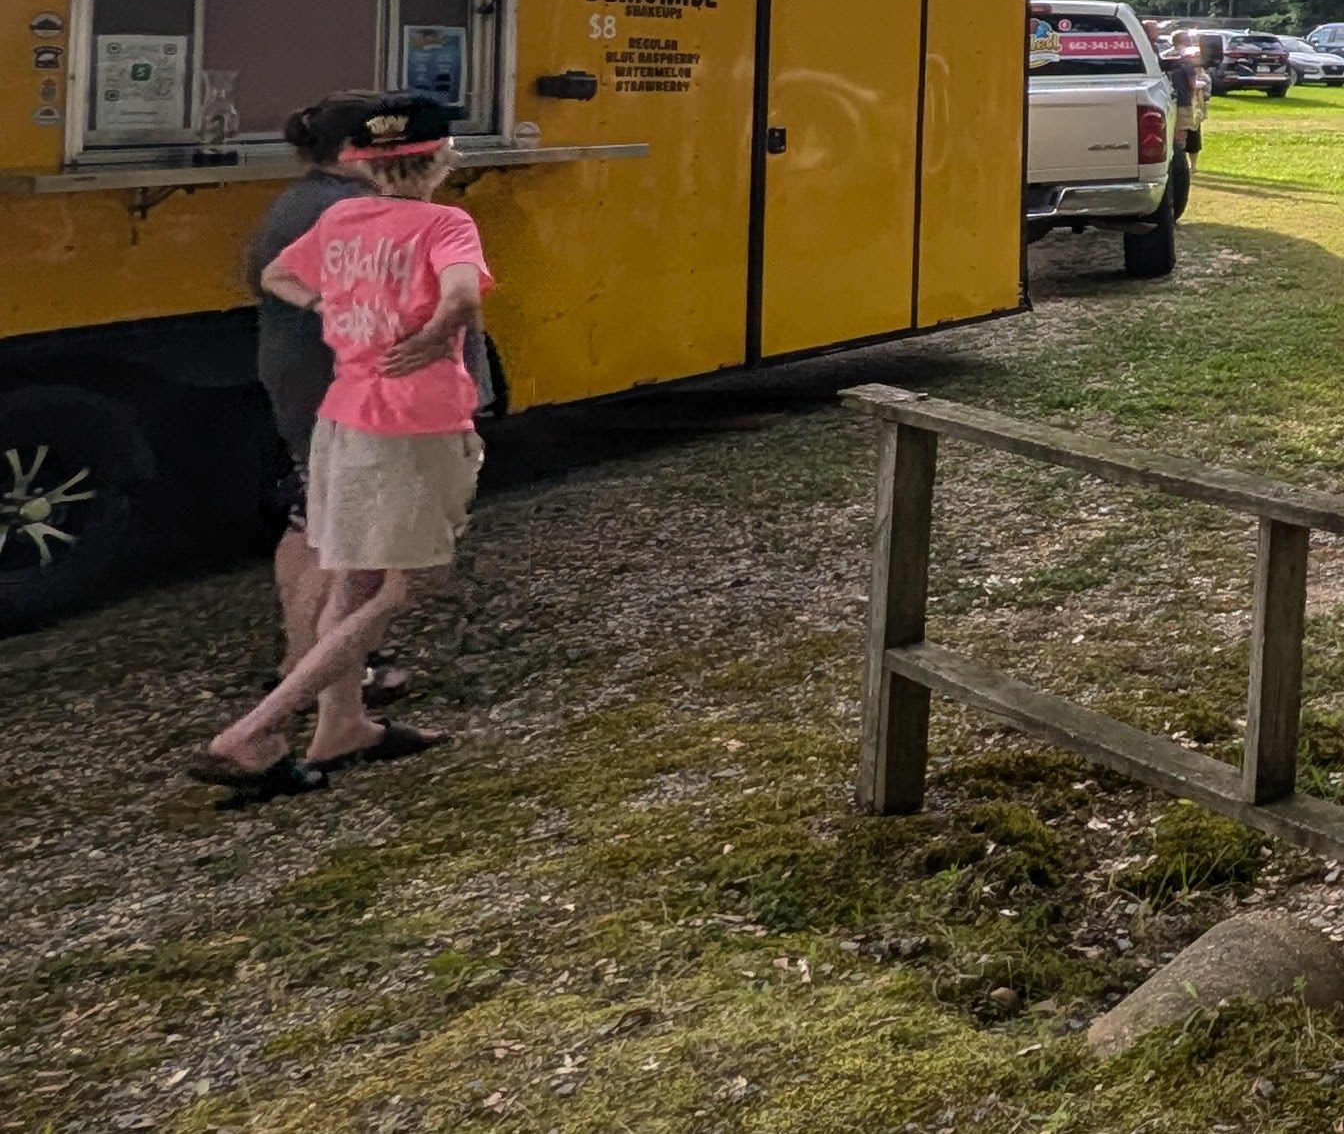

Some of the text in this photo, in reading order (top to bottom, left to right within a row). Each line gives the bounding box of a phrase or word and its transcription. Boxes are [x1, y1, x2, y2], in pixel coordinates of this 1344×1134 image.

[625, 5, 683, 19] SHAKEUPS
[589, 13, 617, 39] $8
[628, 37, 678, 51] REGULAR
[606, 51, 700, 65] BLUE RASPBERRY
[615, 66, 692, 78] WATERMELON
[615, 80, 690, 92] STRAWBERRY
[321, 232, 421, 306] egally
